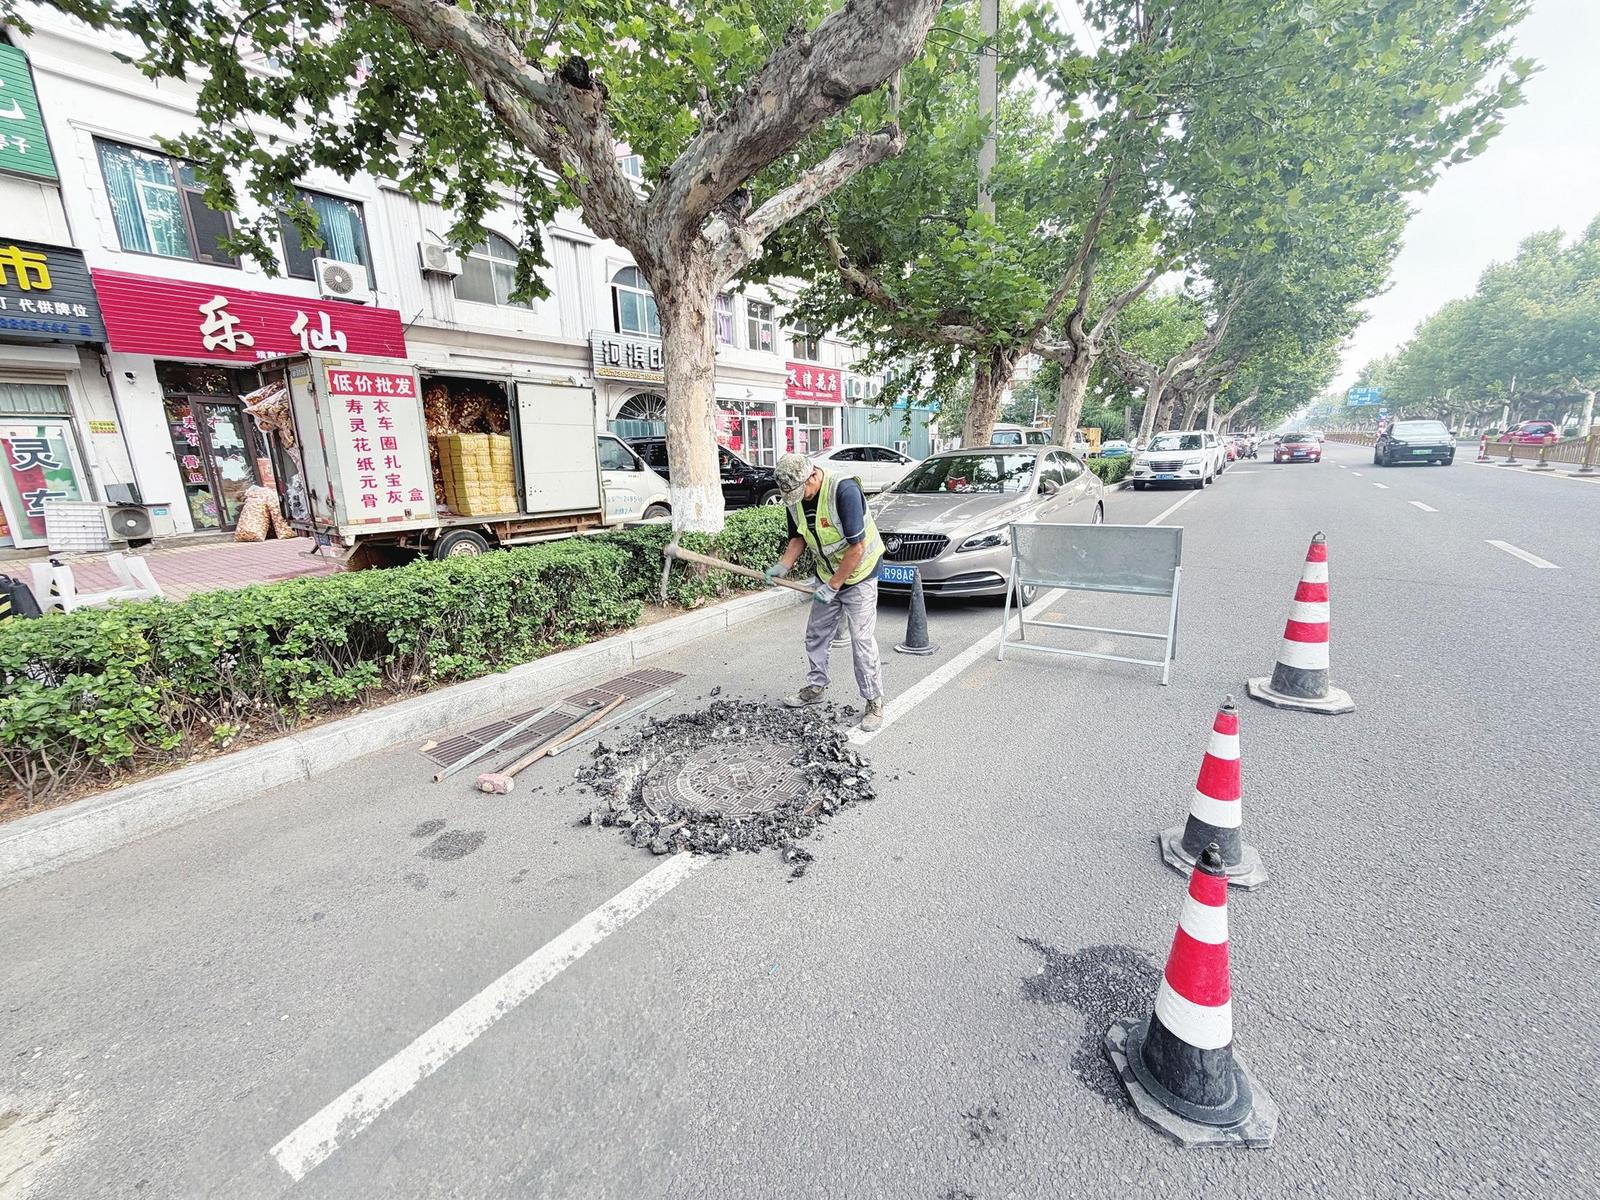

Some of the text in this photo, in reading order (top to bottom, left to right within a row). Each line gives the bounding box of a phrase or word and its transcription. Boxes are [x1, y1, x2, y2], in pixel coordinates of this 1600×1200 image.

[0, 245, 52, 291] 市
[19, 298, 89, 318] 代供牌位
[333, 373, 414, 396] 低价批发
[785, 368, 837, 392] 天津花店
[345, 399, 391, 415] 寿衣
[349, 416, 394, 433] 灵车
[352, 436, 398, 453] 花圈
[356, 455, 402, 472] 纸扎
[359, 473, 403, 490] 元宝
[360, 487, 425, 509] 骨灰盒
